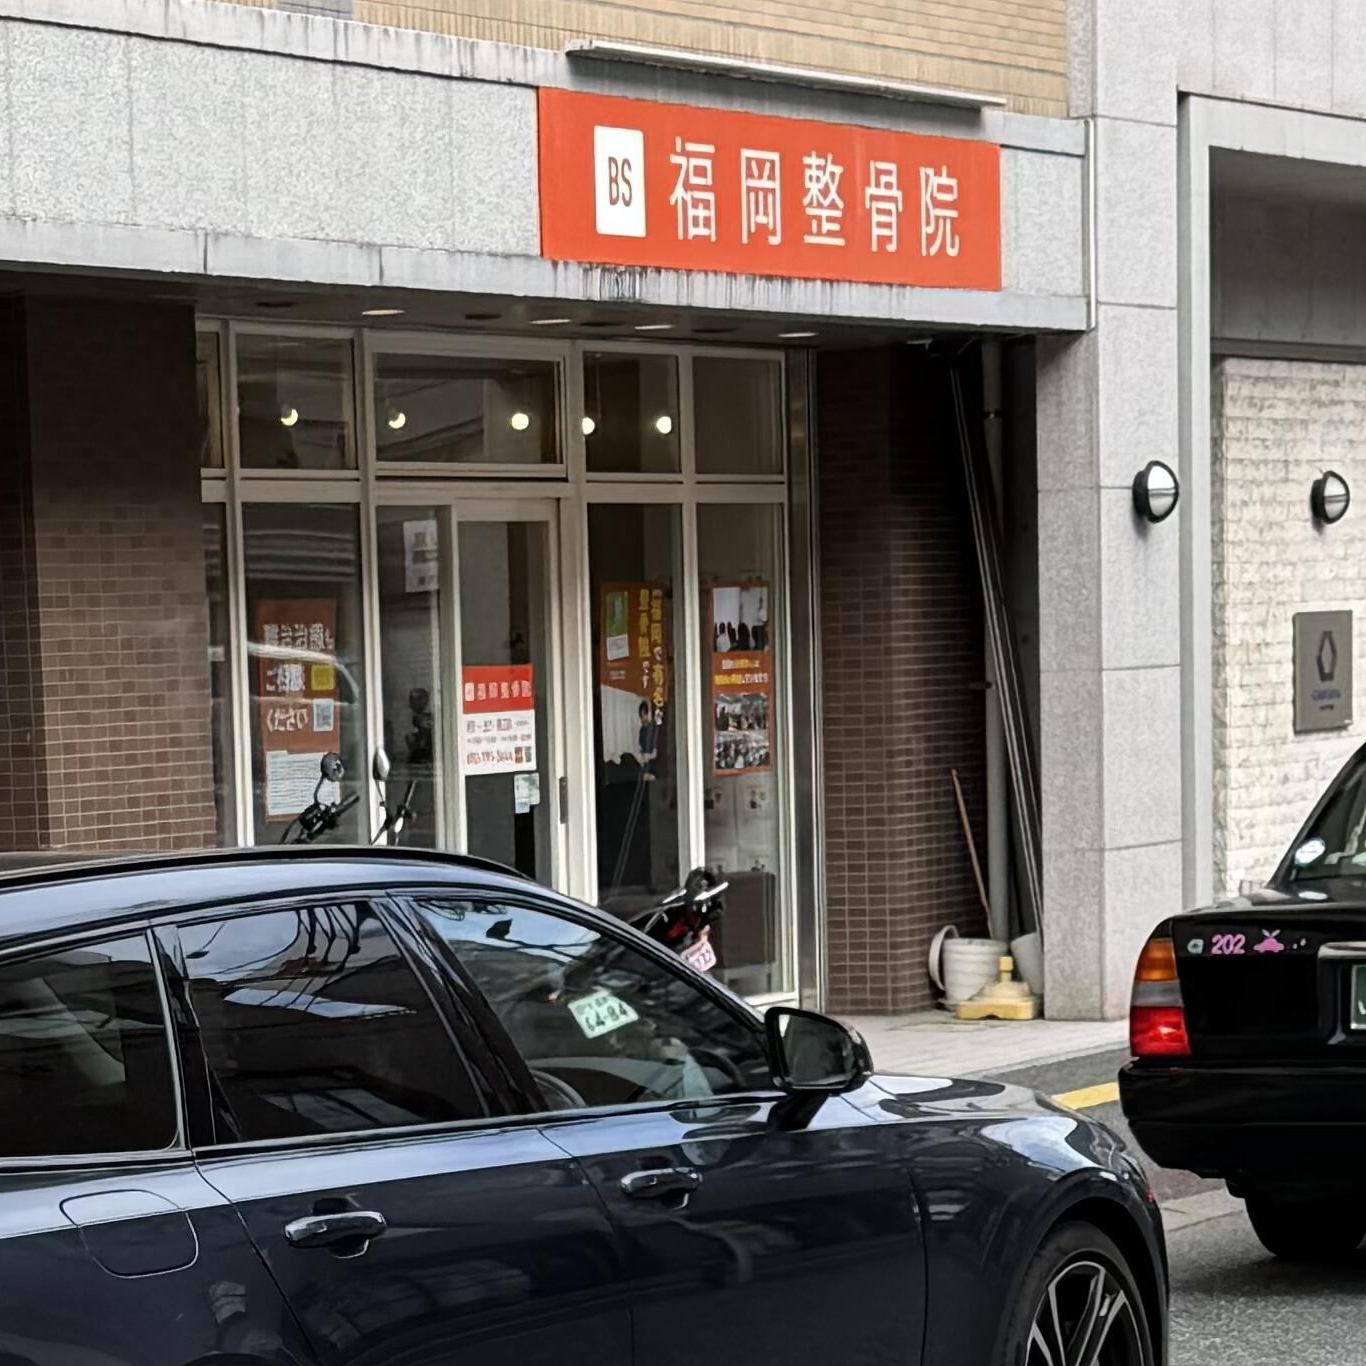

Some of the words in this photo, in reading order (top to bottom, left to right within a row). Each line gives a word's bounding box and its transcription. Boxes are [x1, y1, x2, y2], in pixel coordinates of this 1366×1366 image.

[608, 156, 633, 208] BS
[669, 136, 960, 257] 福岡整骨院
[1211, 934, 1246, 955] 202
